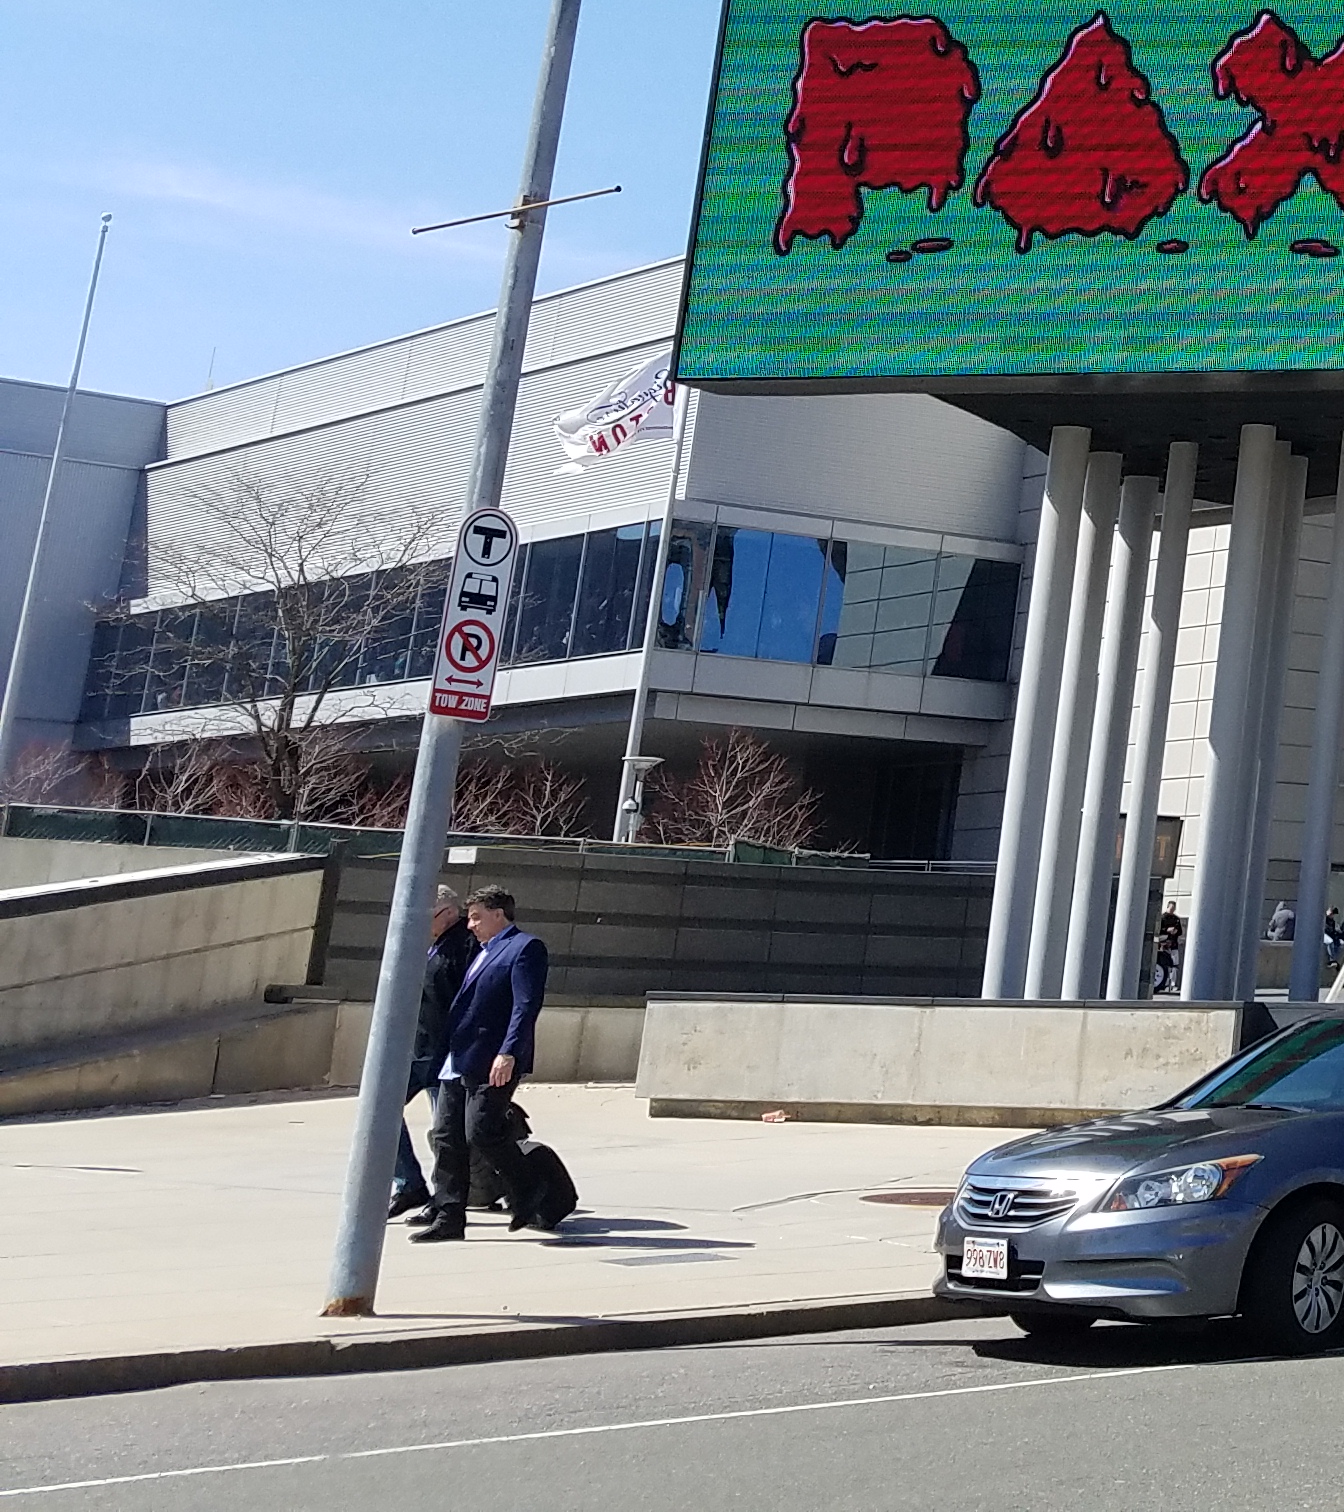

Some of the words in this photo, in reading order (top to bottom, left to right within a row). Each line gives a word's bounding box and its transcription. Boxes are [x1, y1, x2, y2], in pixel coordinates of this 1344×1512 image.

[473, 524, 508, 559] T
[435, 692, 459, 709] TOW
[458, 696, 488, 712] ZONE
[966, 1248, 985, 1268] 998
